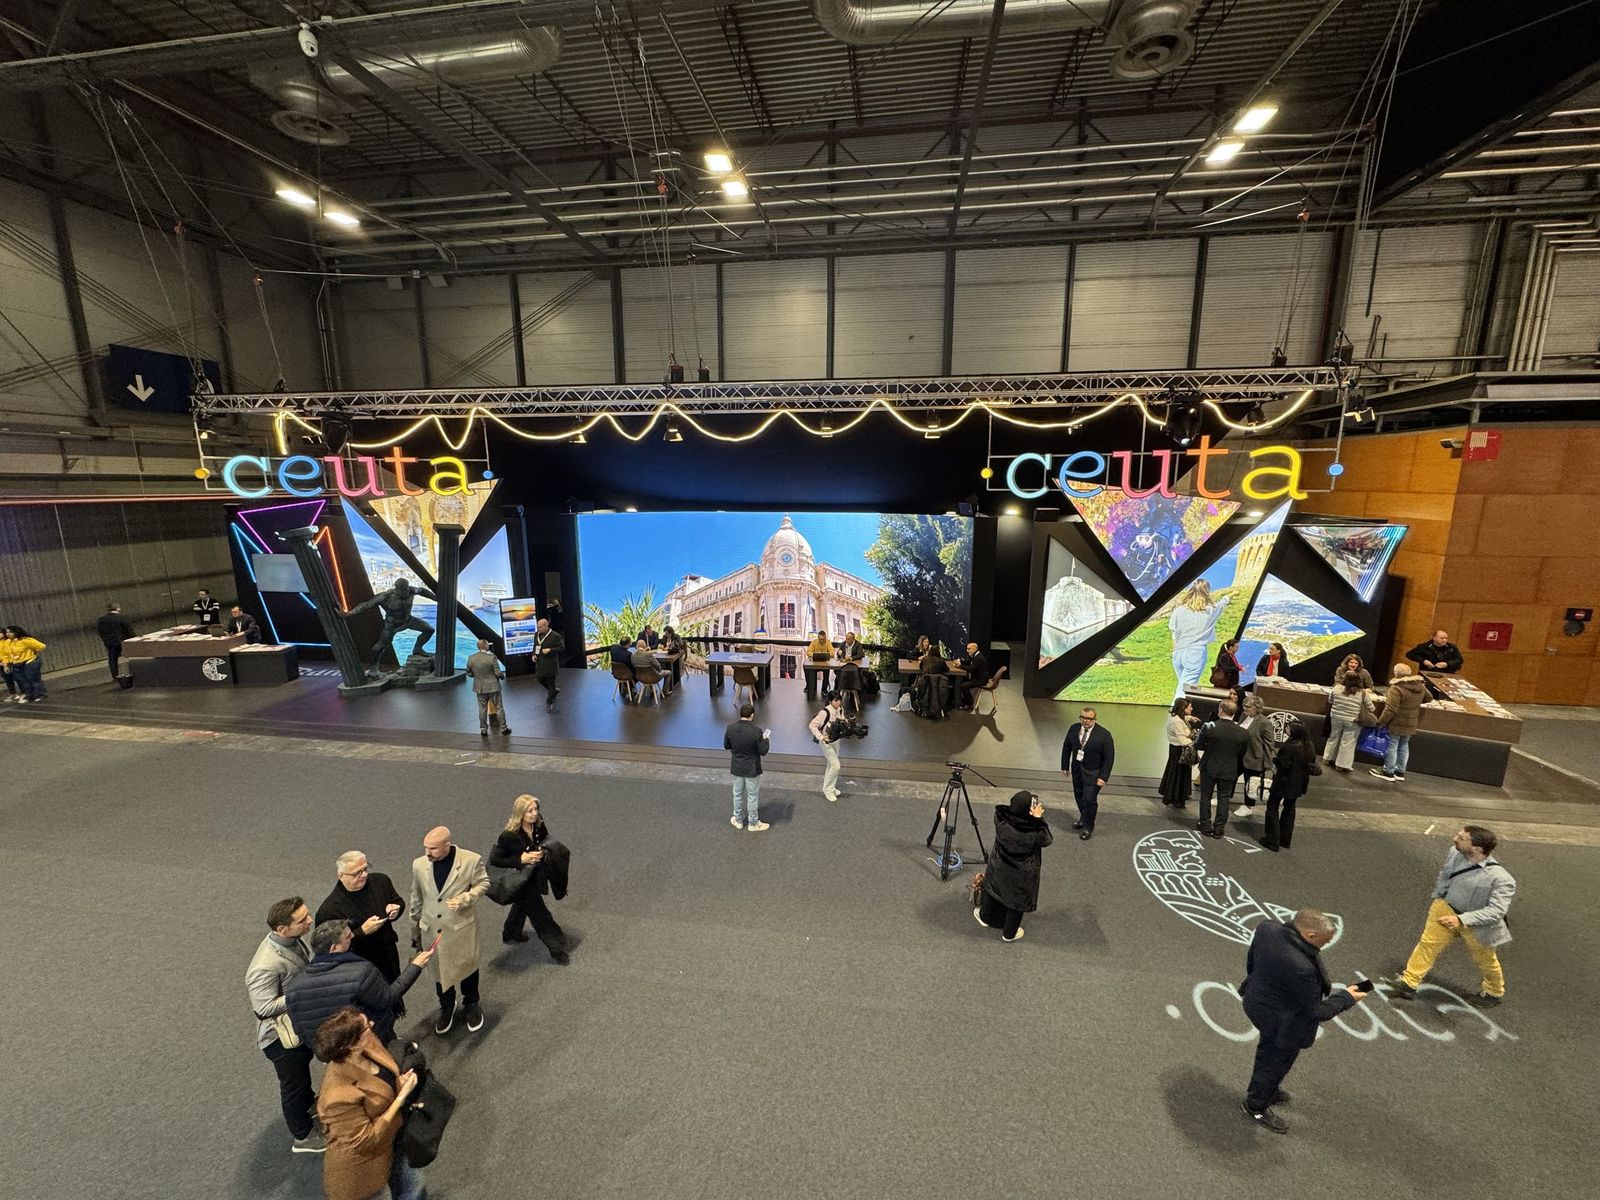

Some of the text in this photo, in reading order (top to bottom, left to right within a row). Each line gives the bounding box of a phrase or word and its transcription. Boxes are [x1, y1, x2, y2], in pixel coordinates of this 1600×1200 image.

[222, 446, 476, 498] ceuta
[1006, 434, 1308, 501] ceuta
[1192, 971, 1519, 1042] cuta
